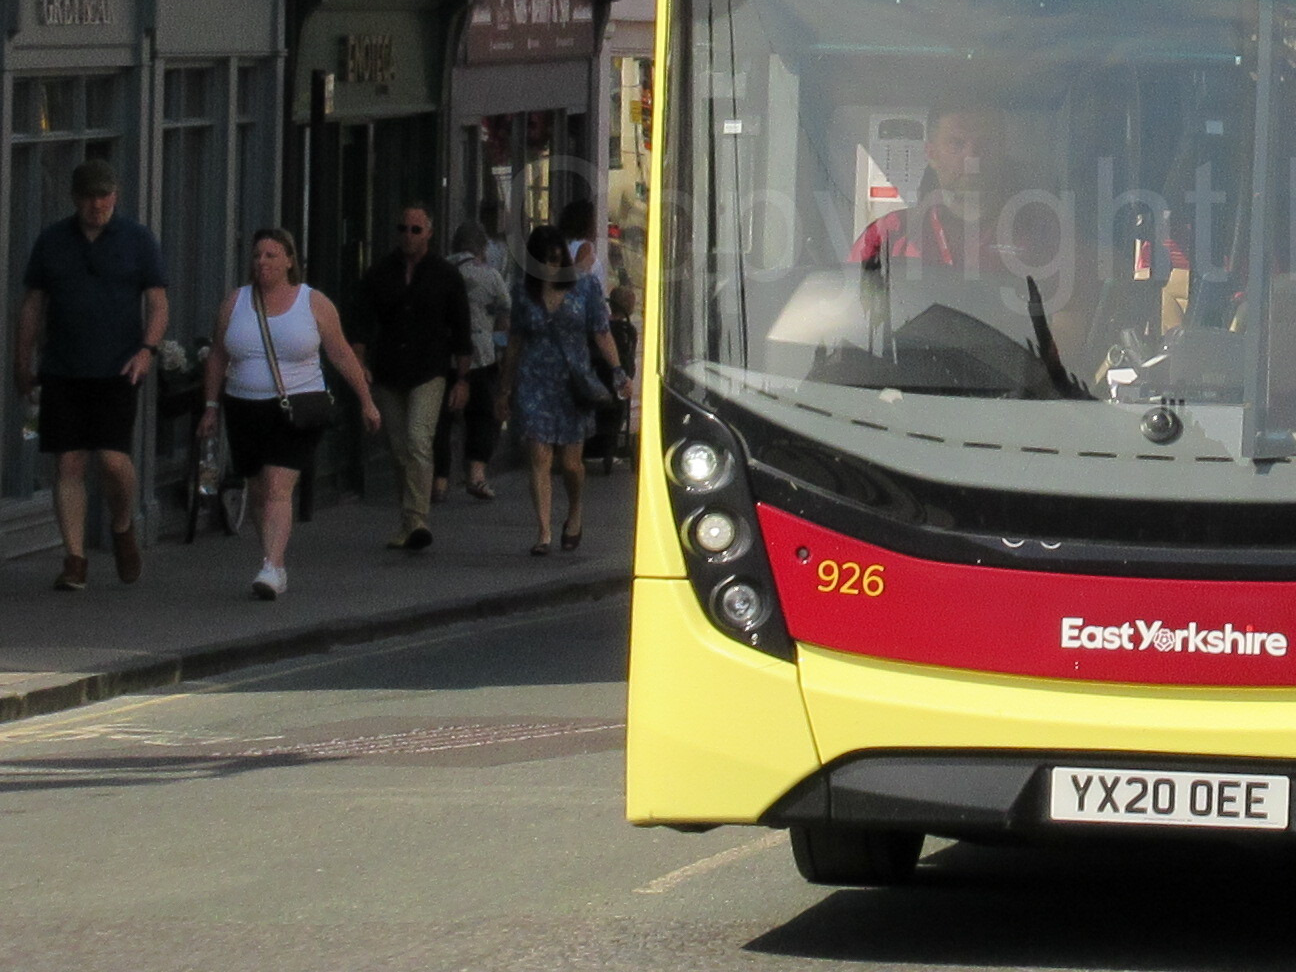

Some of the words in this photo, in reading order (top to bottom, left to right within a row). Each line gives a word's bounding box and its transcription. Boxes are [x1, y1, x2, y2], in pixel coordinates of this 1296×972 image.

[816, 560, 886, 597] 926
[1071, 774, 1175, 818] YX20
[1188, 781, 1271, 821] OEE
